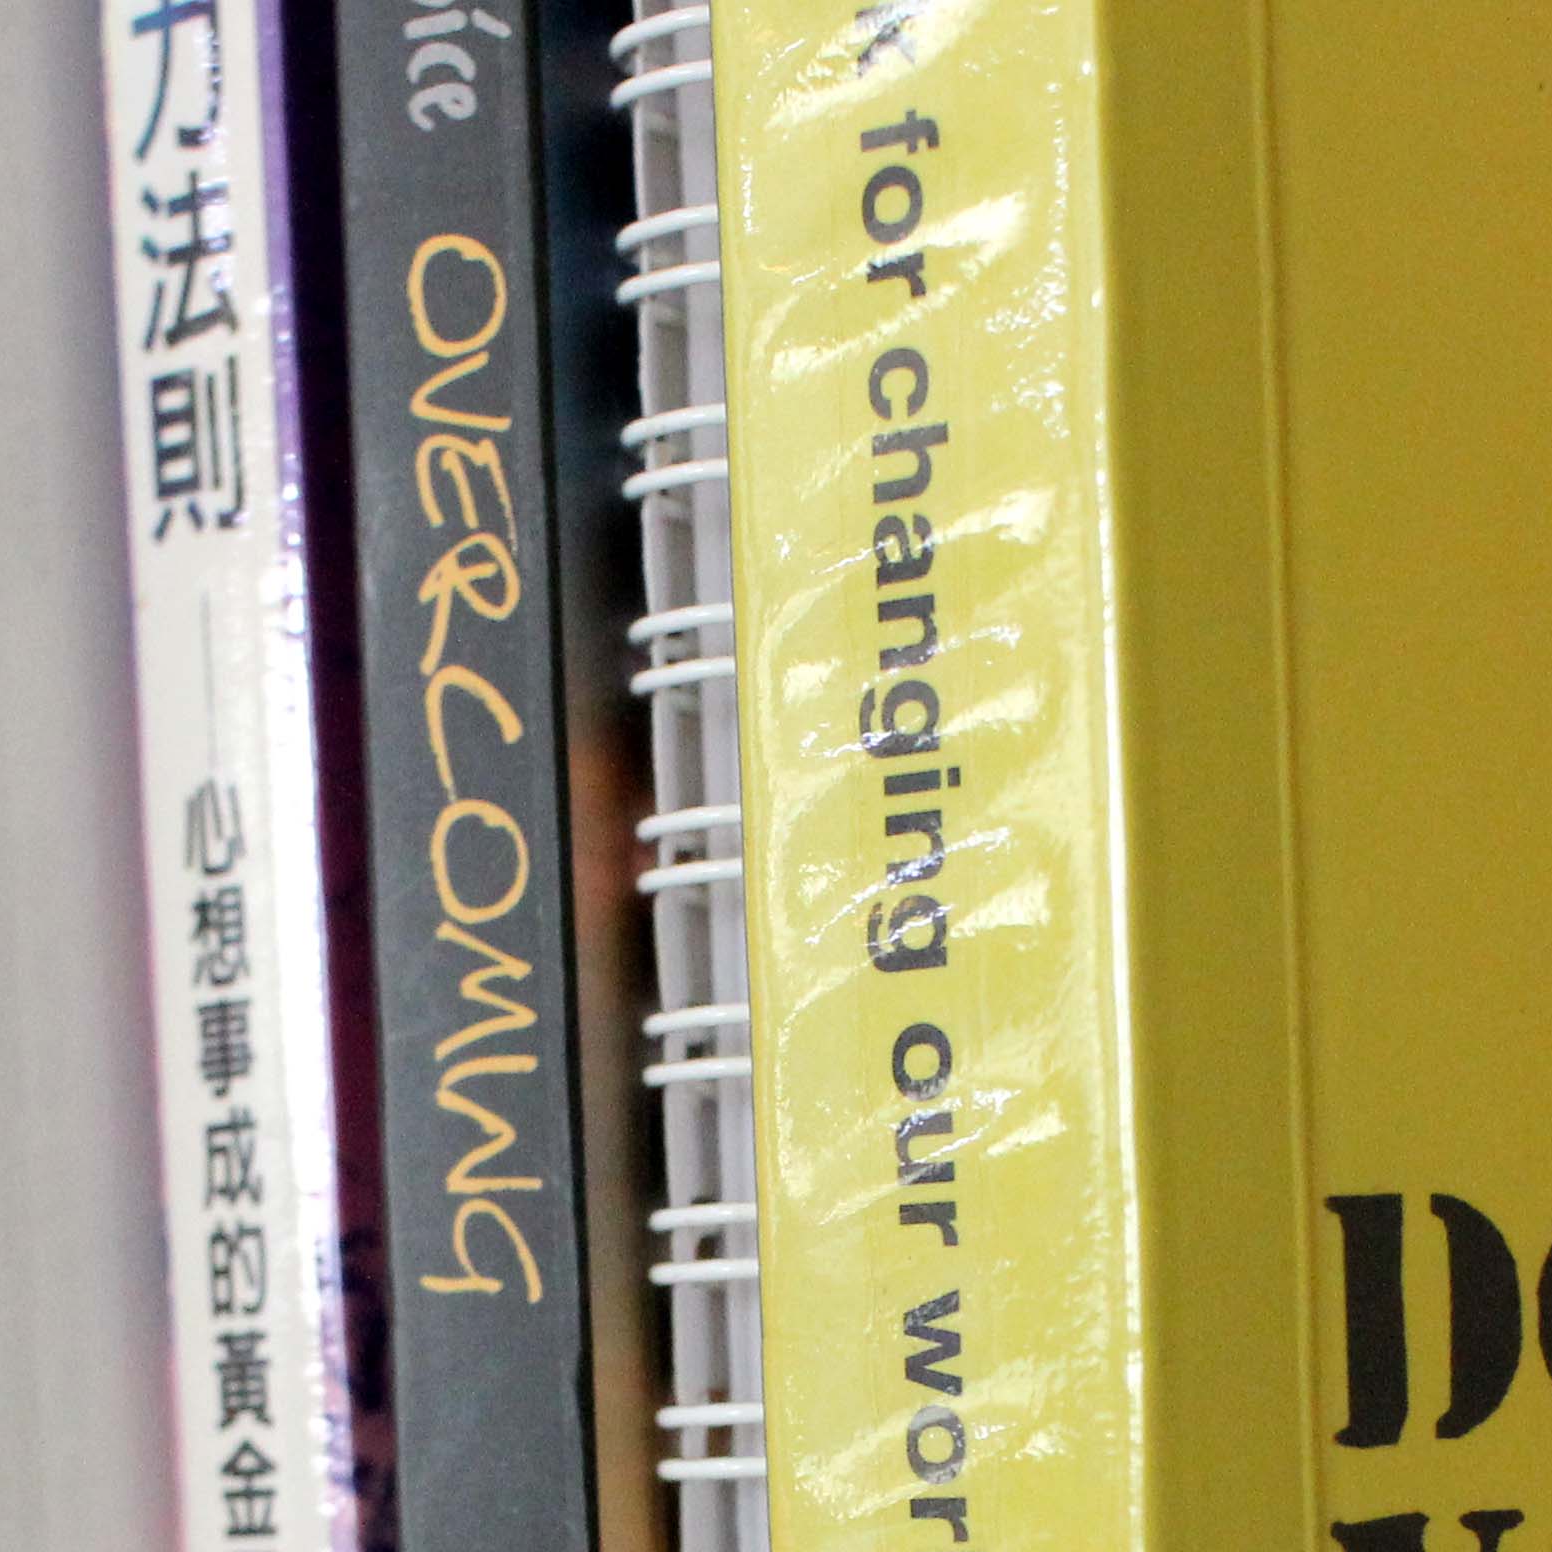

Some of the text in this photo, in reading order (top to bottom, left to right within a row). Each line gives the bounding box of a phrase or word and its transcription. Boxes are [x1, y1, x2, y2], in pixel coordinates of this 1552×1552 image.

[860, 109, 940, 298] for
[403, 0, 544, 1304] ice OVERCOMING
[859, 347, 962, 973] changing
[891, 1022, 960, 1247] our
